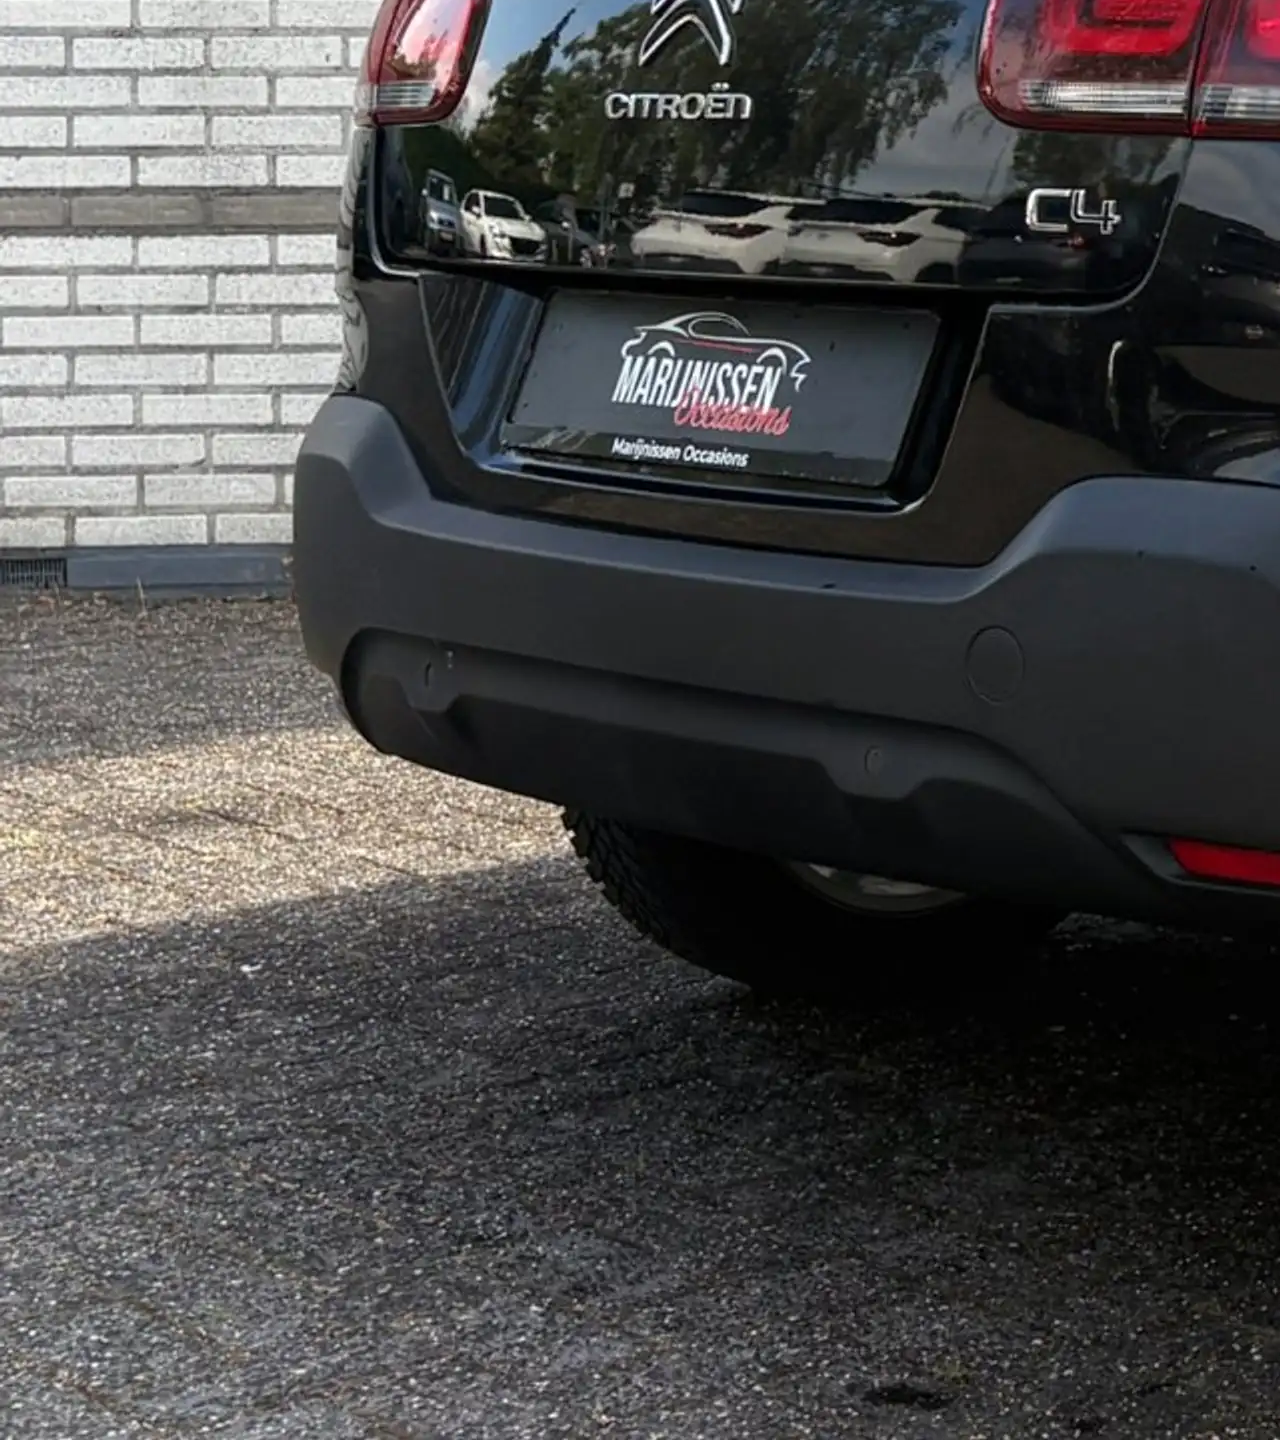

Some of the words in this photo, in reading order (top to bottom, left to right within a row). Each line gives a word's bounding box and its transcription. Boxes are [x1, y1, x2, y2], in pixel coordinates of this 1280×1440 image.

[604, 83, 753, 120] CITROËN
[1025, 188, 1121, 236] C4
[611, 355, 783, 415] MARIJNISSEN
[611, 437, 681, 460] Marijnissen
[682, 444, 750, 468] Occasions
